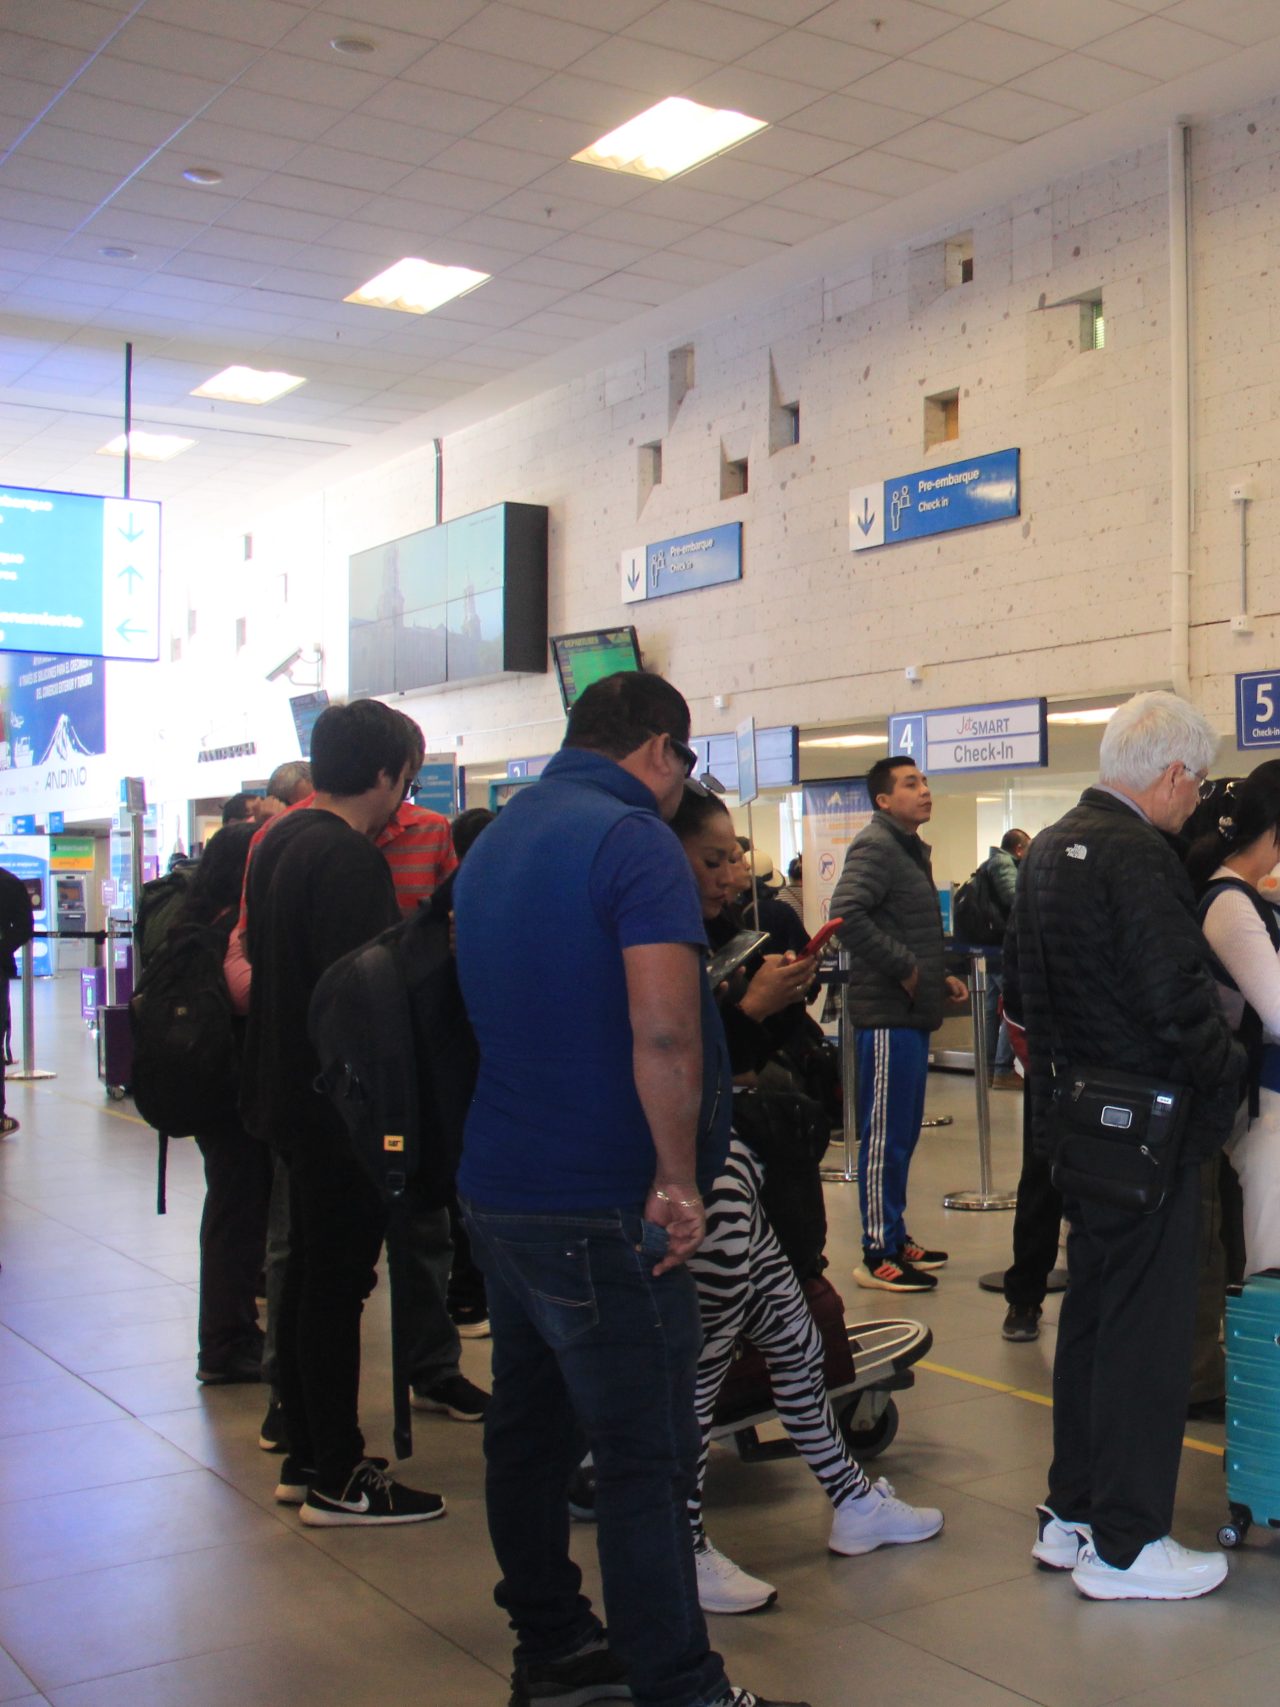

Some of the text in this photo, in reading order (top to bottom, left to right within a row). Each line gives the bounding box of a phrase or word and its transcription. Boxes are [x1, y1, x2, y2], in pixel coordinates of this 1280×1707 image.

[918, 469, 980, 493] Pre-embarque
[918, 498, 940, 512] Check
[670, 538, 715, 557] Pre-embarque
[1256, 683, 1274, 723] 5
[956, 715, 1010, 735] JetSMART
[1252, 727, 1280, 738] Check-in
[900, 723, 914, 755] 4
[953, 741, 1014, 763] Check-In
[45, 766, 87, 790] ANDINO
